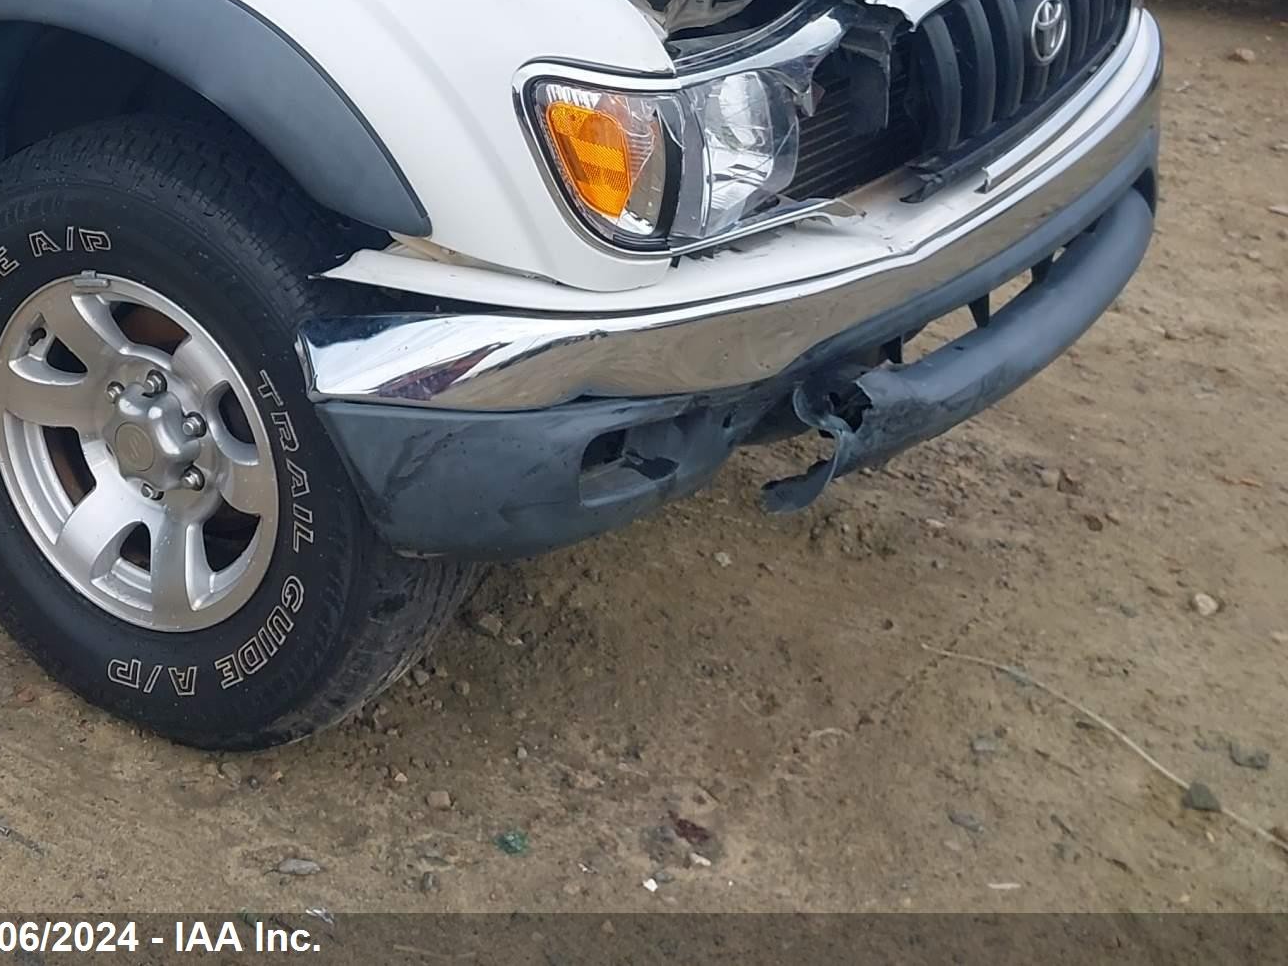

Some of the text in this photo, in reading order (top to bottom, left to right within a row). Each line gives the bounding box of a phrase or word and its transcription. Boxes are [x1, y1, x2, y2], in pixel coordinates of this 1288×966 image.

[28, 225, 113, 259] A/P
[107, 369, 315, 697] TRAIL GUIDE A/P
